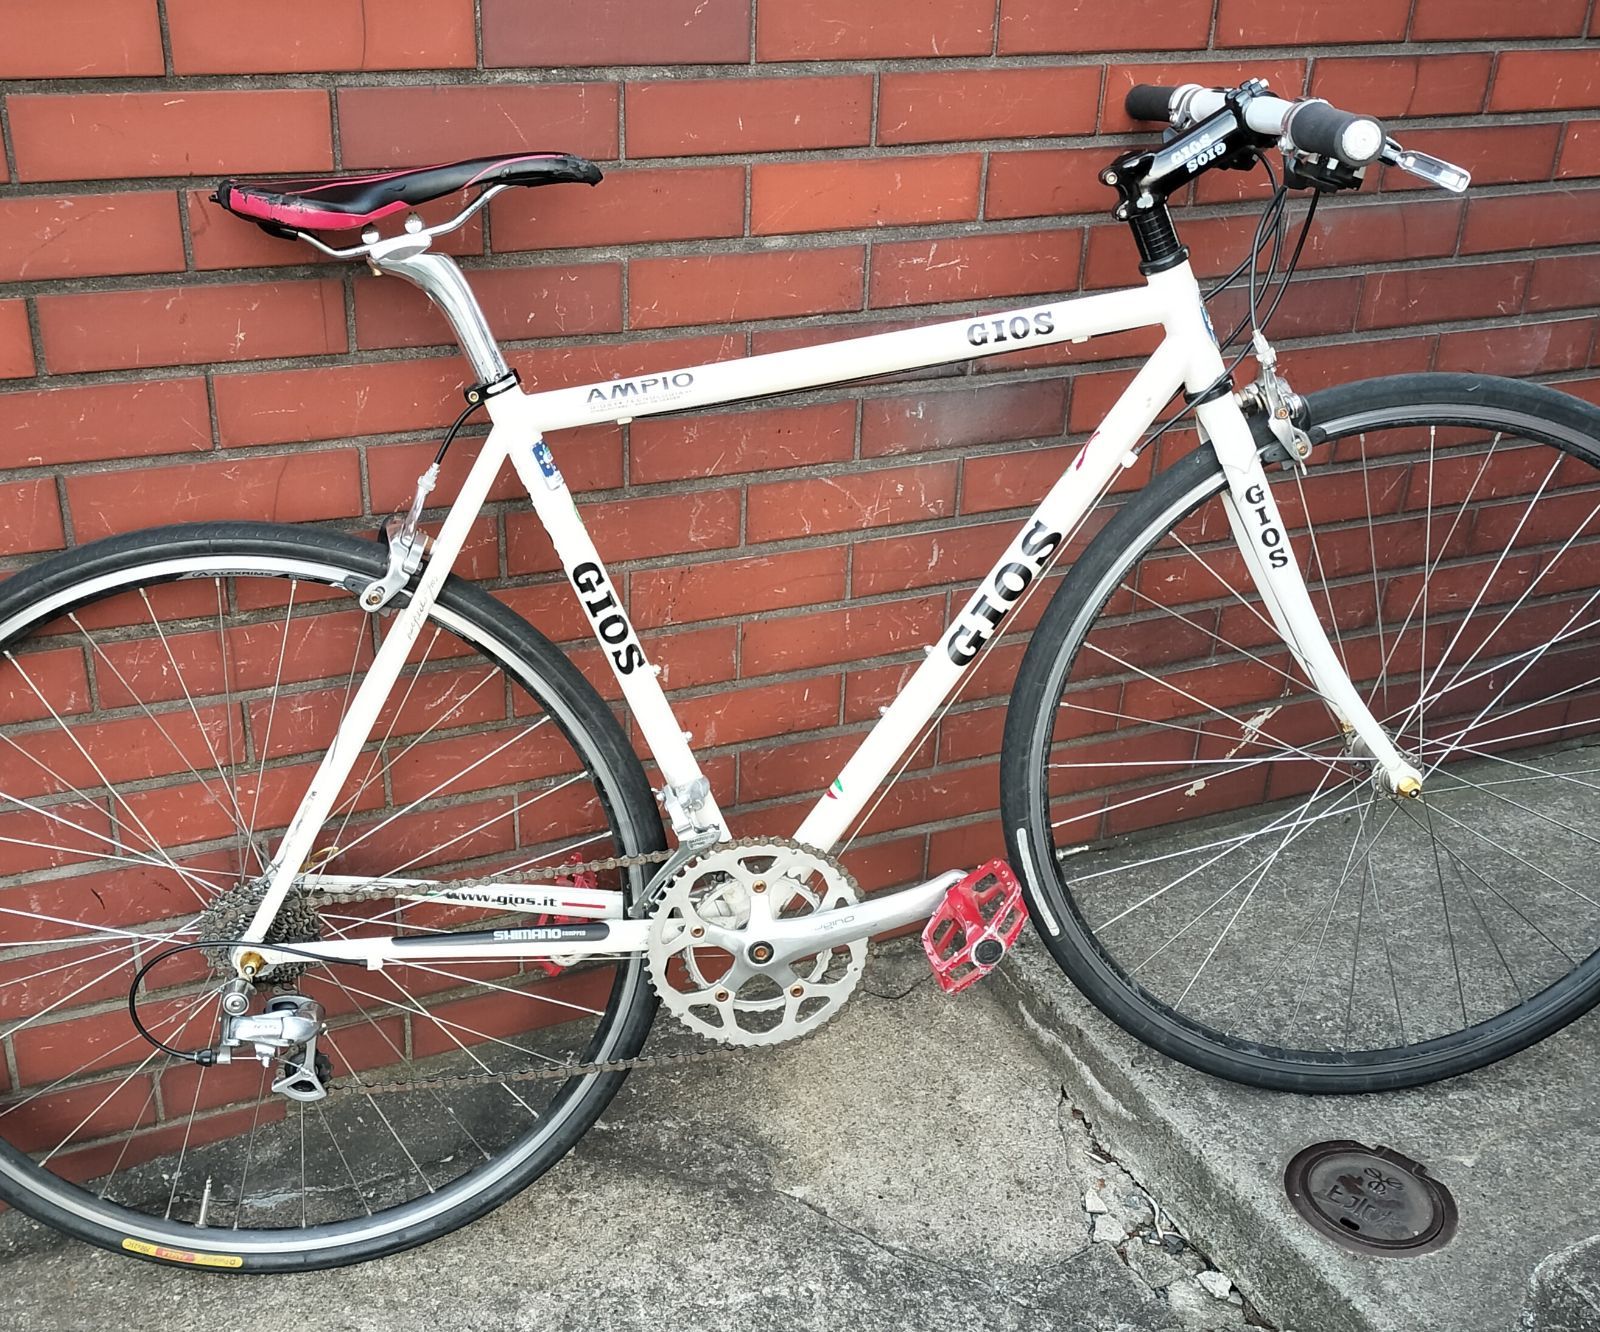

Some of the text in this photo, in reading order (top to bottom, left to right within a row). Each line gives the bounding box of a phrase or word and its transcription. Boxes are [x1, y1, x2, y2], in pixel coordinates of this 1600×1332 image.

[1186, 142, 1227, 174] GIOS
[967, 311, 1055, 346] GIOS
[586, 372, 694, 403] AMPIO
[1245, 483, 1289, 570] GIOS
[947, 520, 1062, 666] GIOS
[572, 561, 646, 675] GIOS
[444, 890, 558, 908] www.gios.it
[493, 929, 561, 941] SHIMANO
